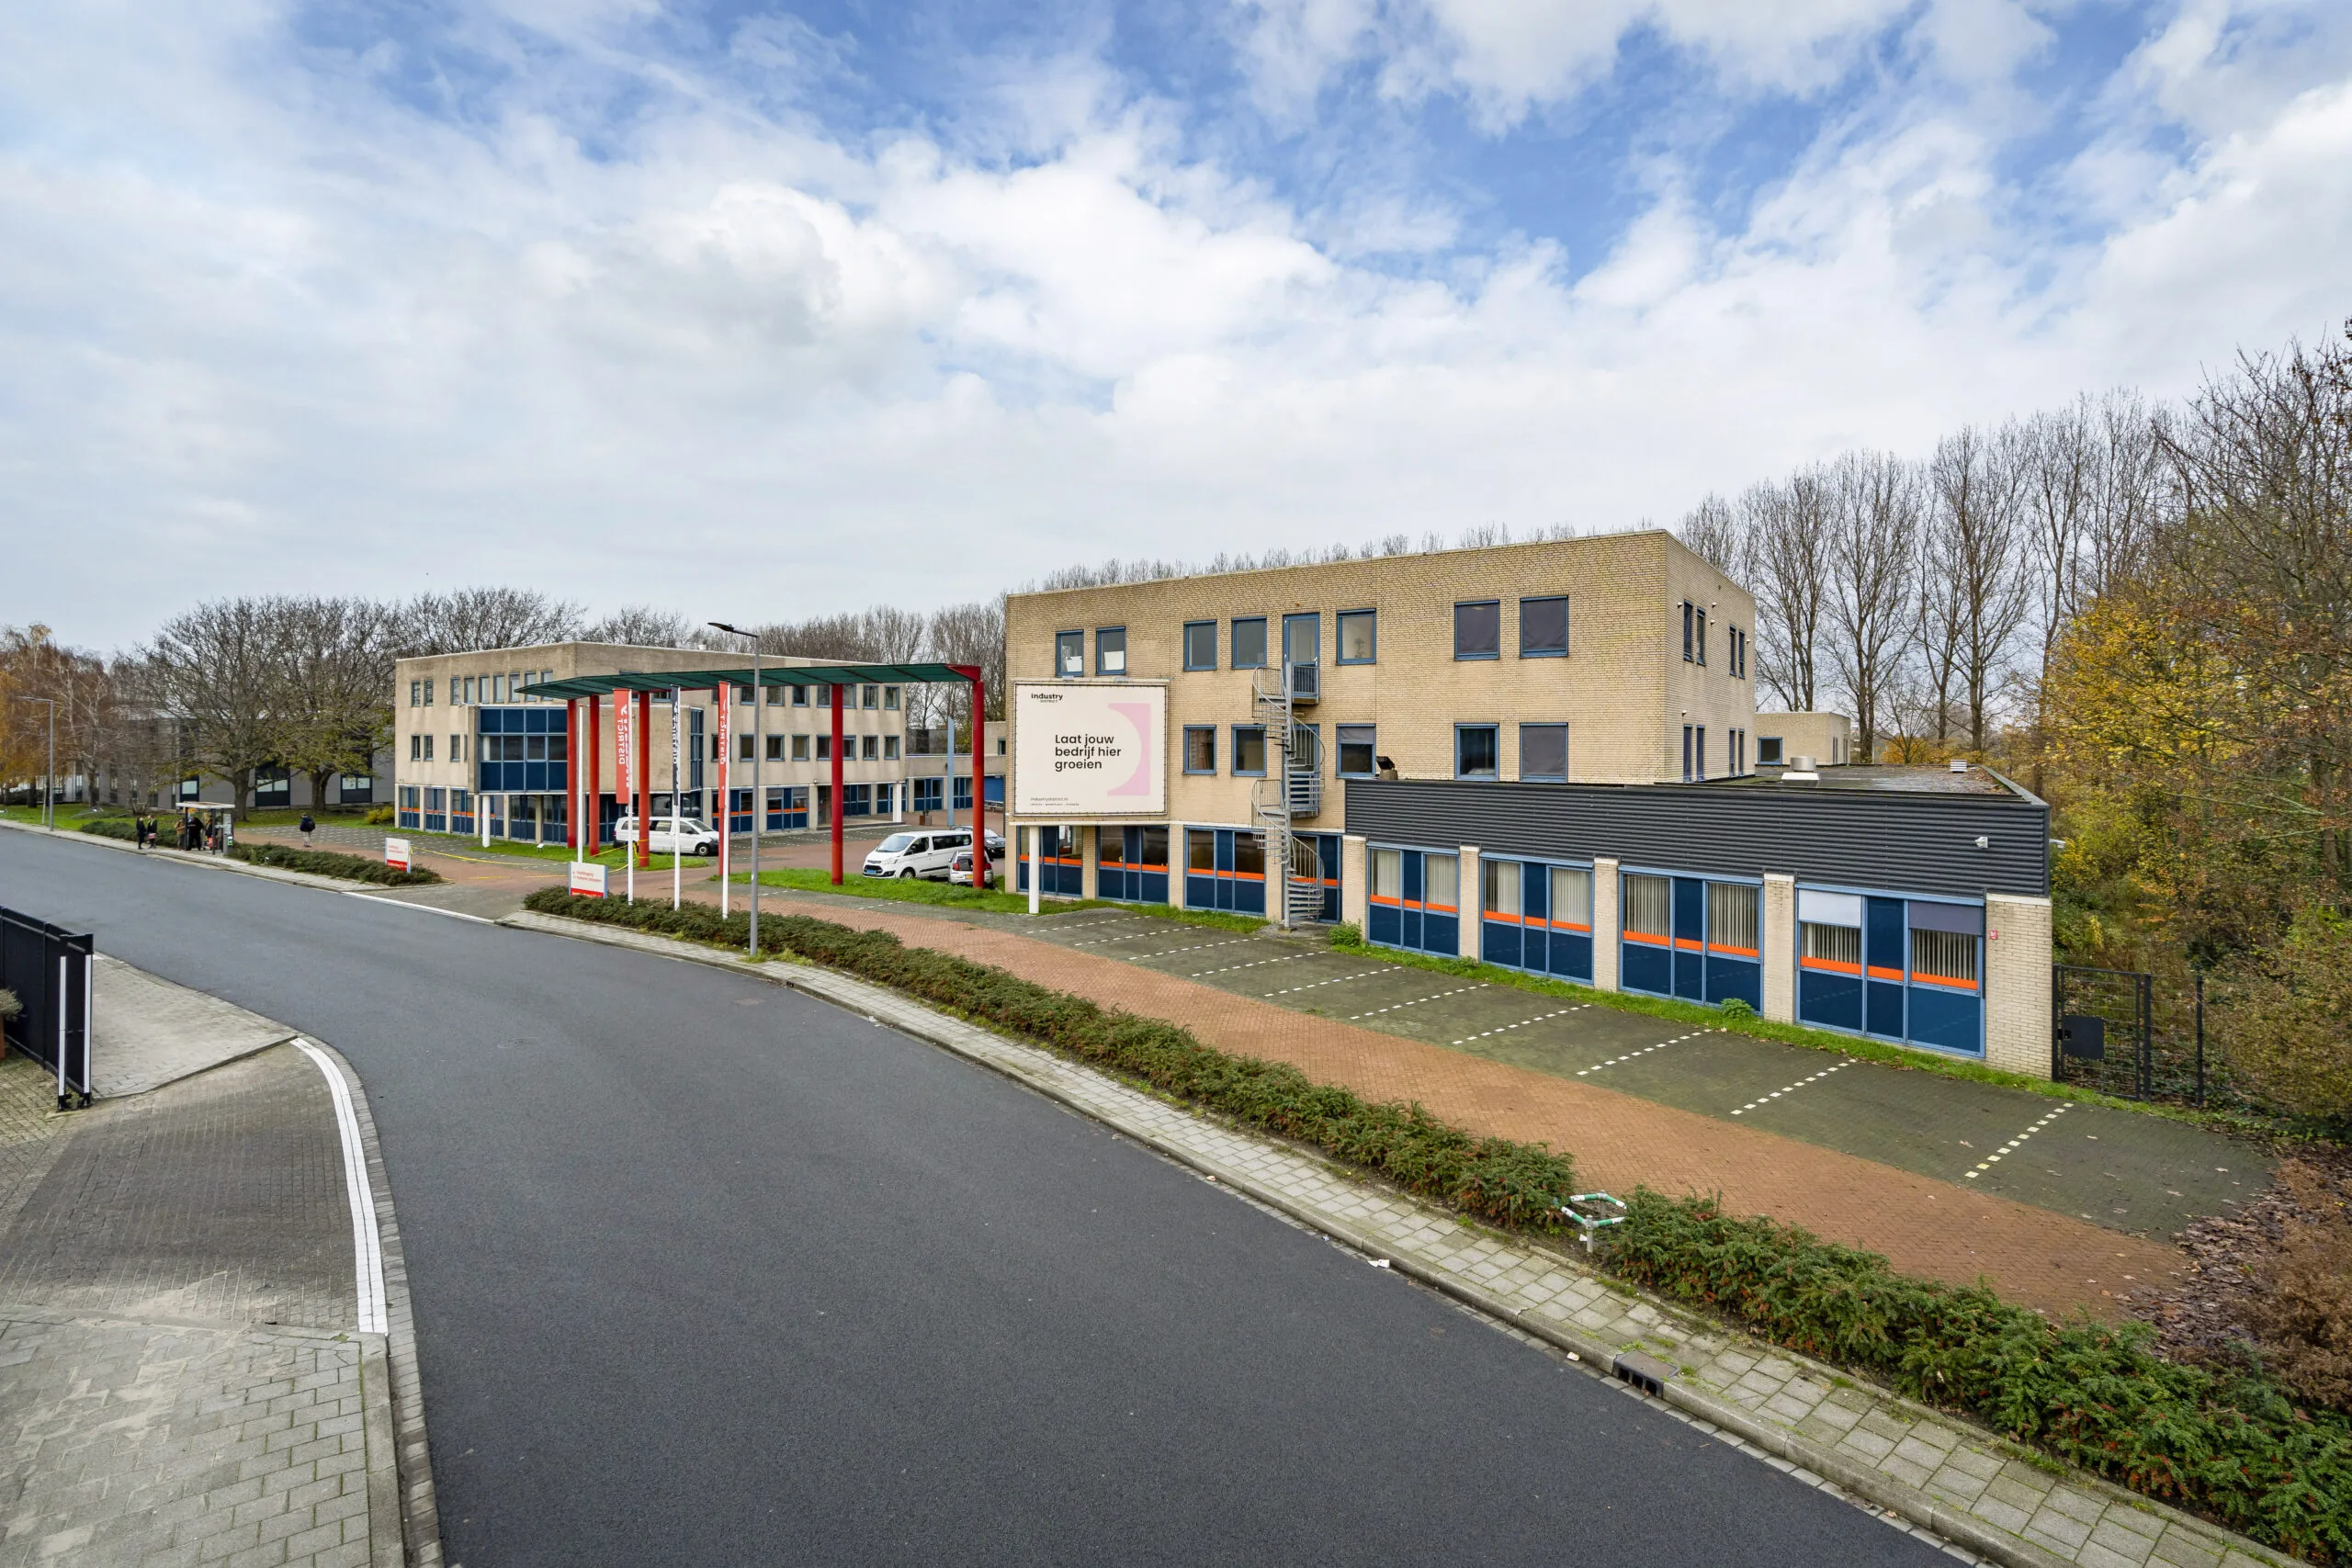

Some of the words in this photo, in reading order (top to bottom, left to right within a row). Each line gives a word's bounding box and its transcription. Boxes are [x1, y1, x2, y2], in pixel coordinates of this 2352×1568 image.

[1055, 734, 1082, 744] Laat
[1084, 733, 1114, 747] jouw
[1055, 746, 1095, 760] bedrijf
[1098, 746, 1122, 757] hier
[1055, 759, 1102, 773] groeien
